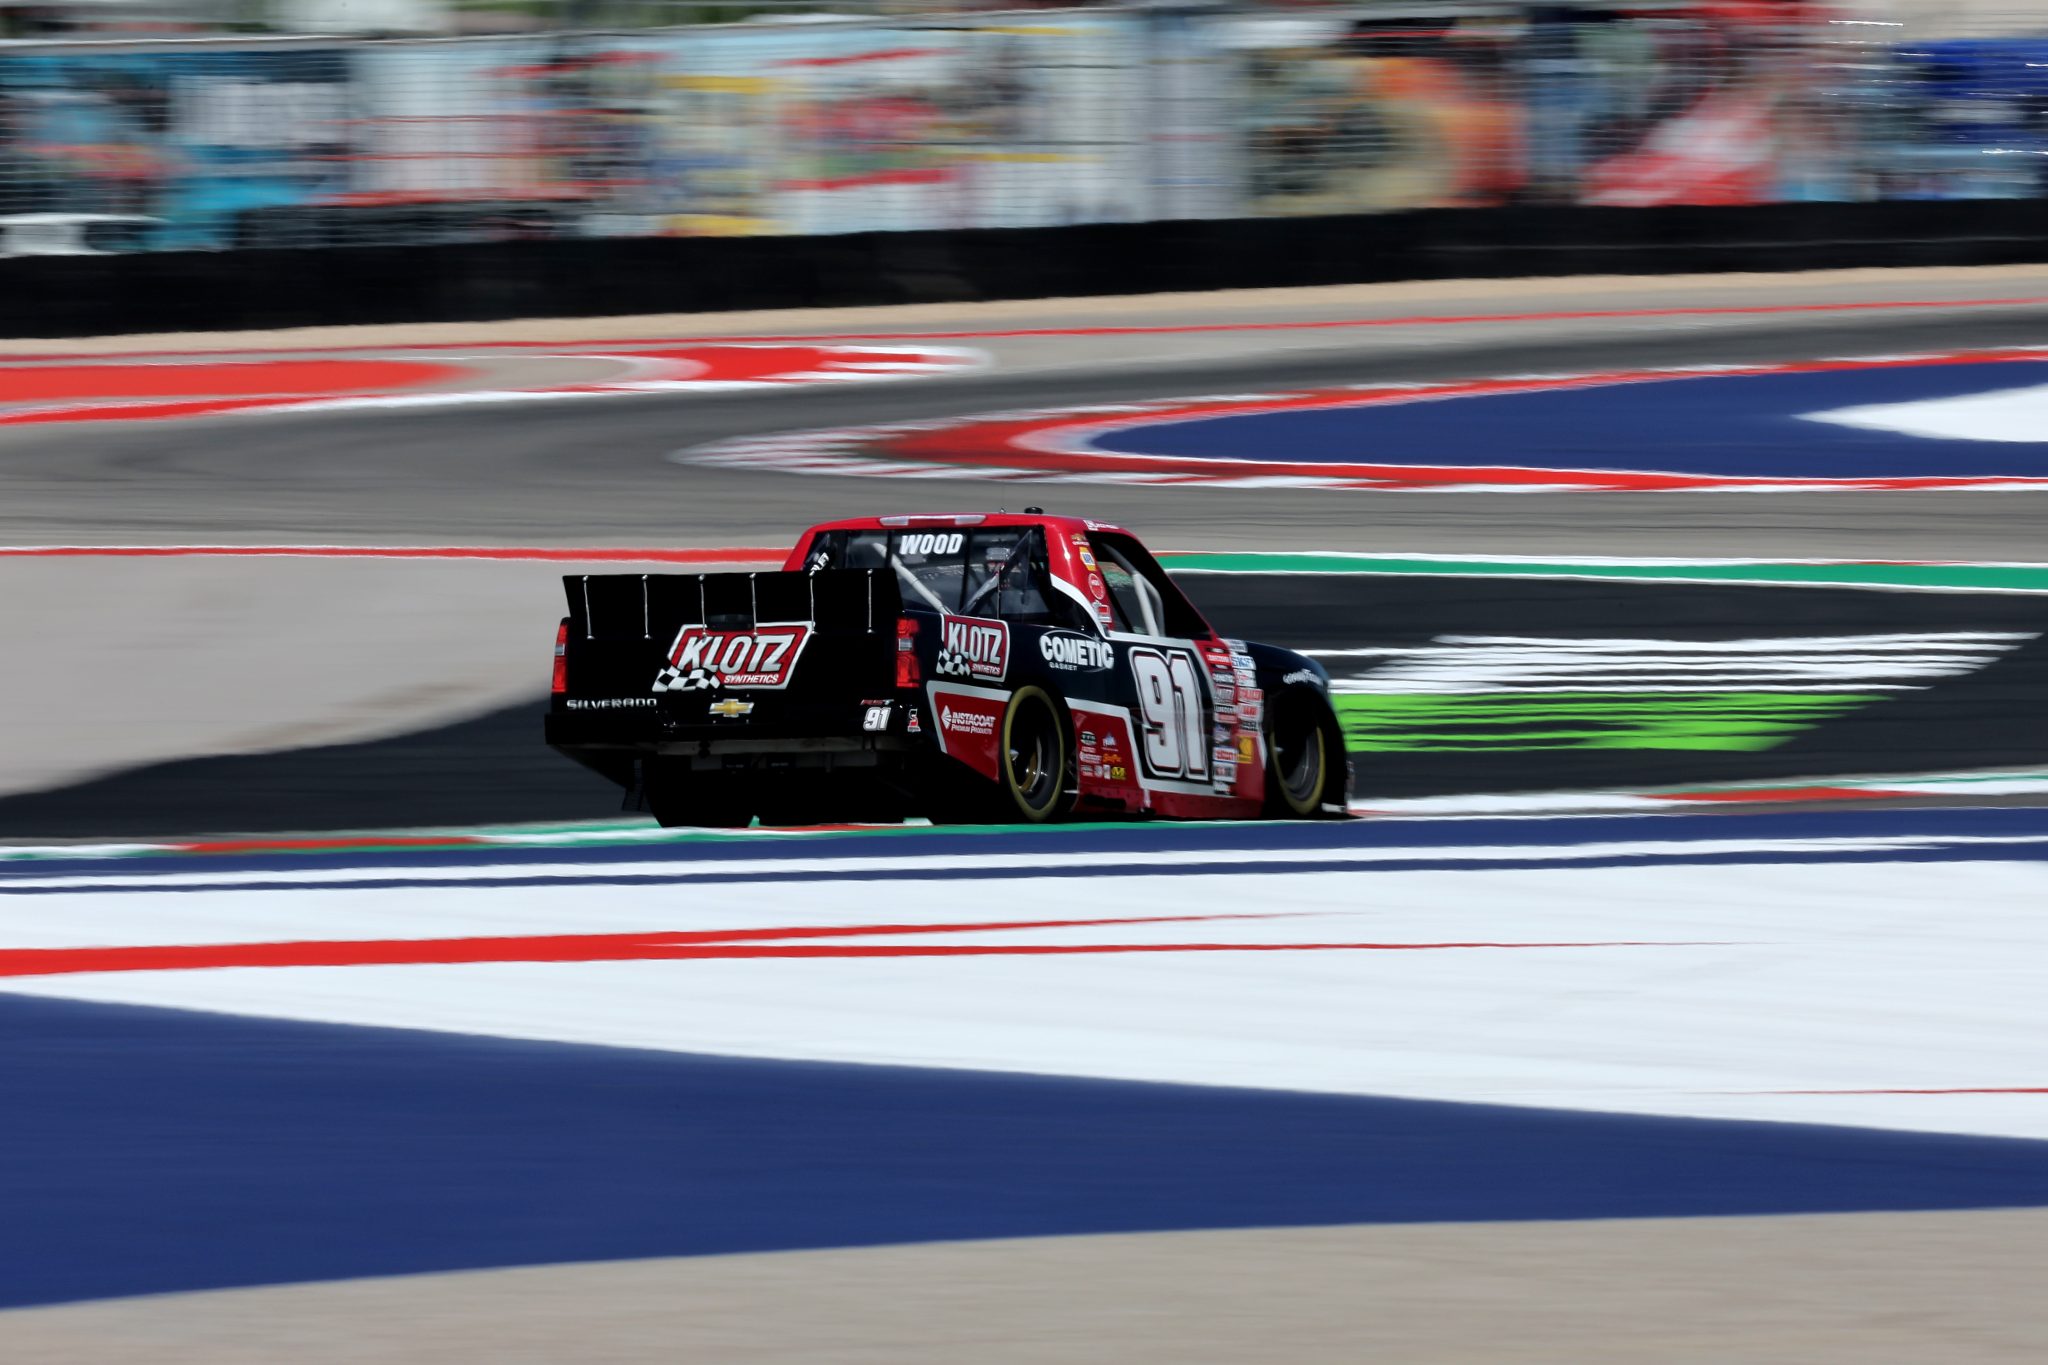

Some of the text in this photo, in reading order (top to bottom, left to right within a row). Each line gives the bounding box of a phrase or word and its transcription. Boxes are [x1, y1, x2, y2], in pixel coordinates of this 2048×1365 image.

[900, 533, 964, 555] WOOD
[677, 633, 796, 675] KLOTZ
[948, 621, 1003, 664] KLOTZ
[1039, 635, 1115, 669] COMETIC
[724, 674, 780, 684] SYNTHETICS
[972, 663, 1001, 676] SYNTHETICS
[566, 698, 657, 710] SILVERADO
[1129, 647, 1209, 781] 91
[863, 706, 892, 731] 91
[951, 711, 997, 728] INSTACOAT
